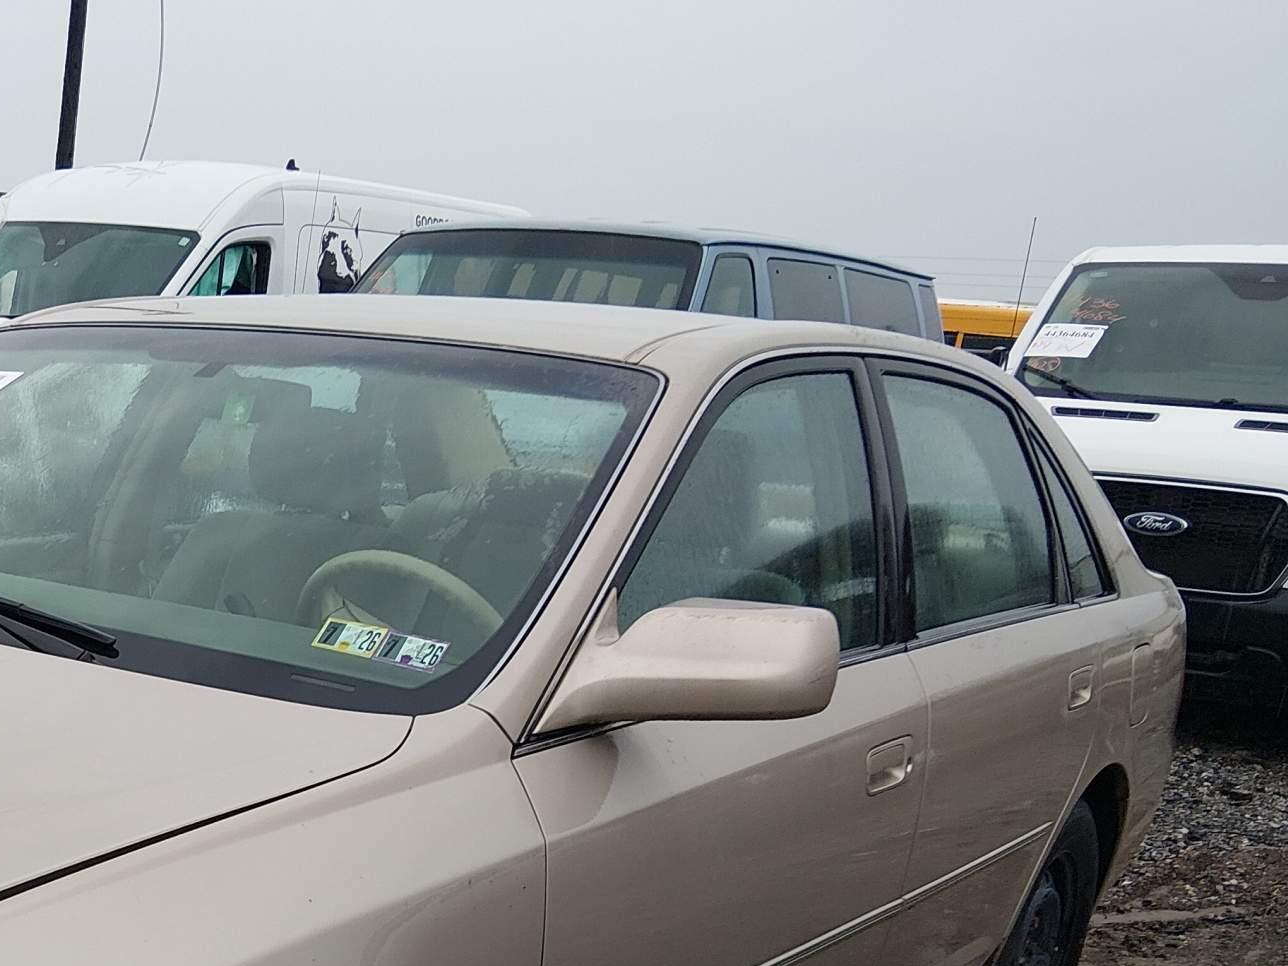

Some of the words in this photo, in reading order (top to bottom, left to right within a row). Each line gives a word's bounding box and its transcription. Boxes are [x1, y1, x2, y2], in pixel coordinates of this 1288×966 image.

[1136, 515, 1173, 530] Ford
[358, 630, 381, 652] 26
[383, 639, 396, 658] 7
[420, 644, 444, 666] 26
